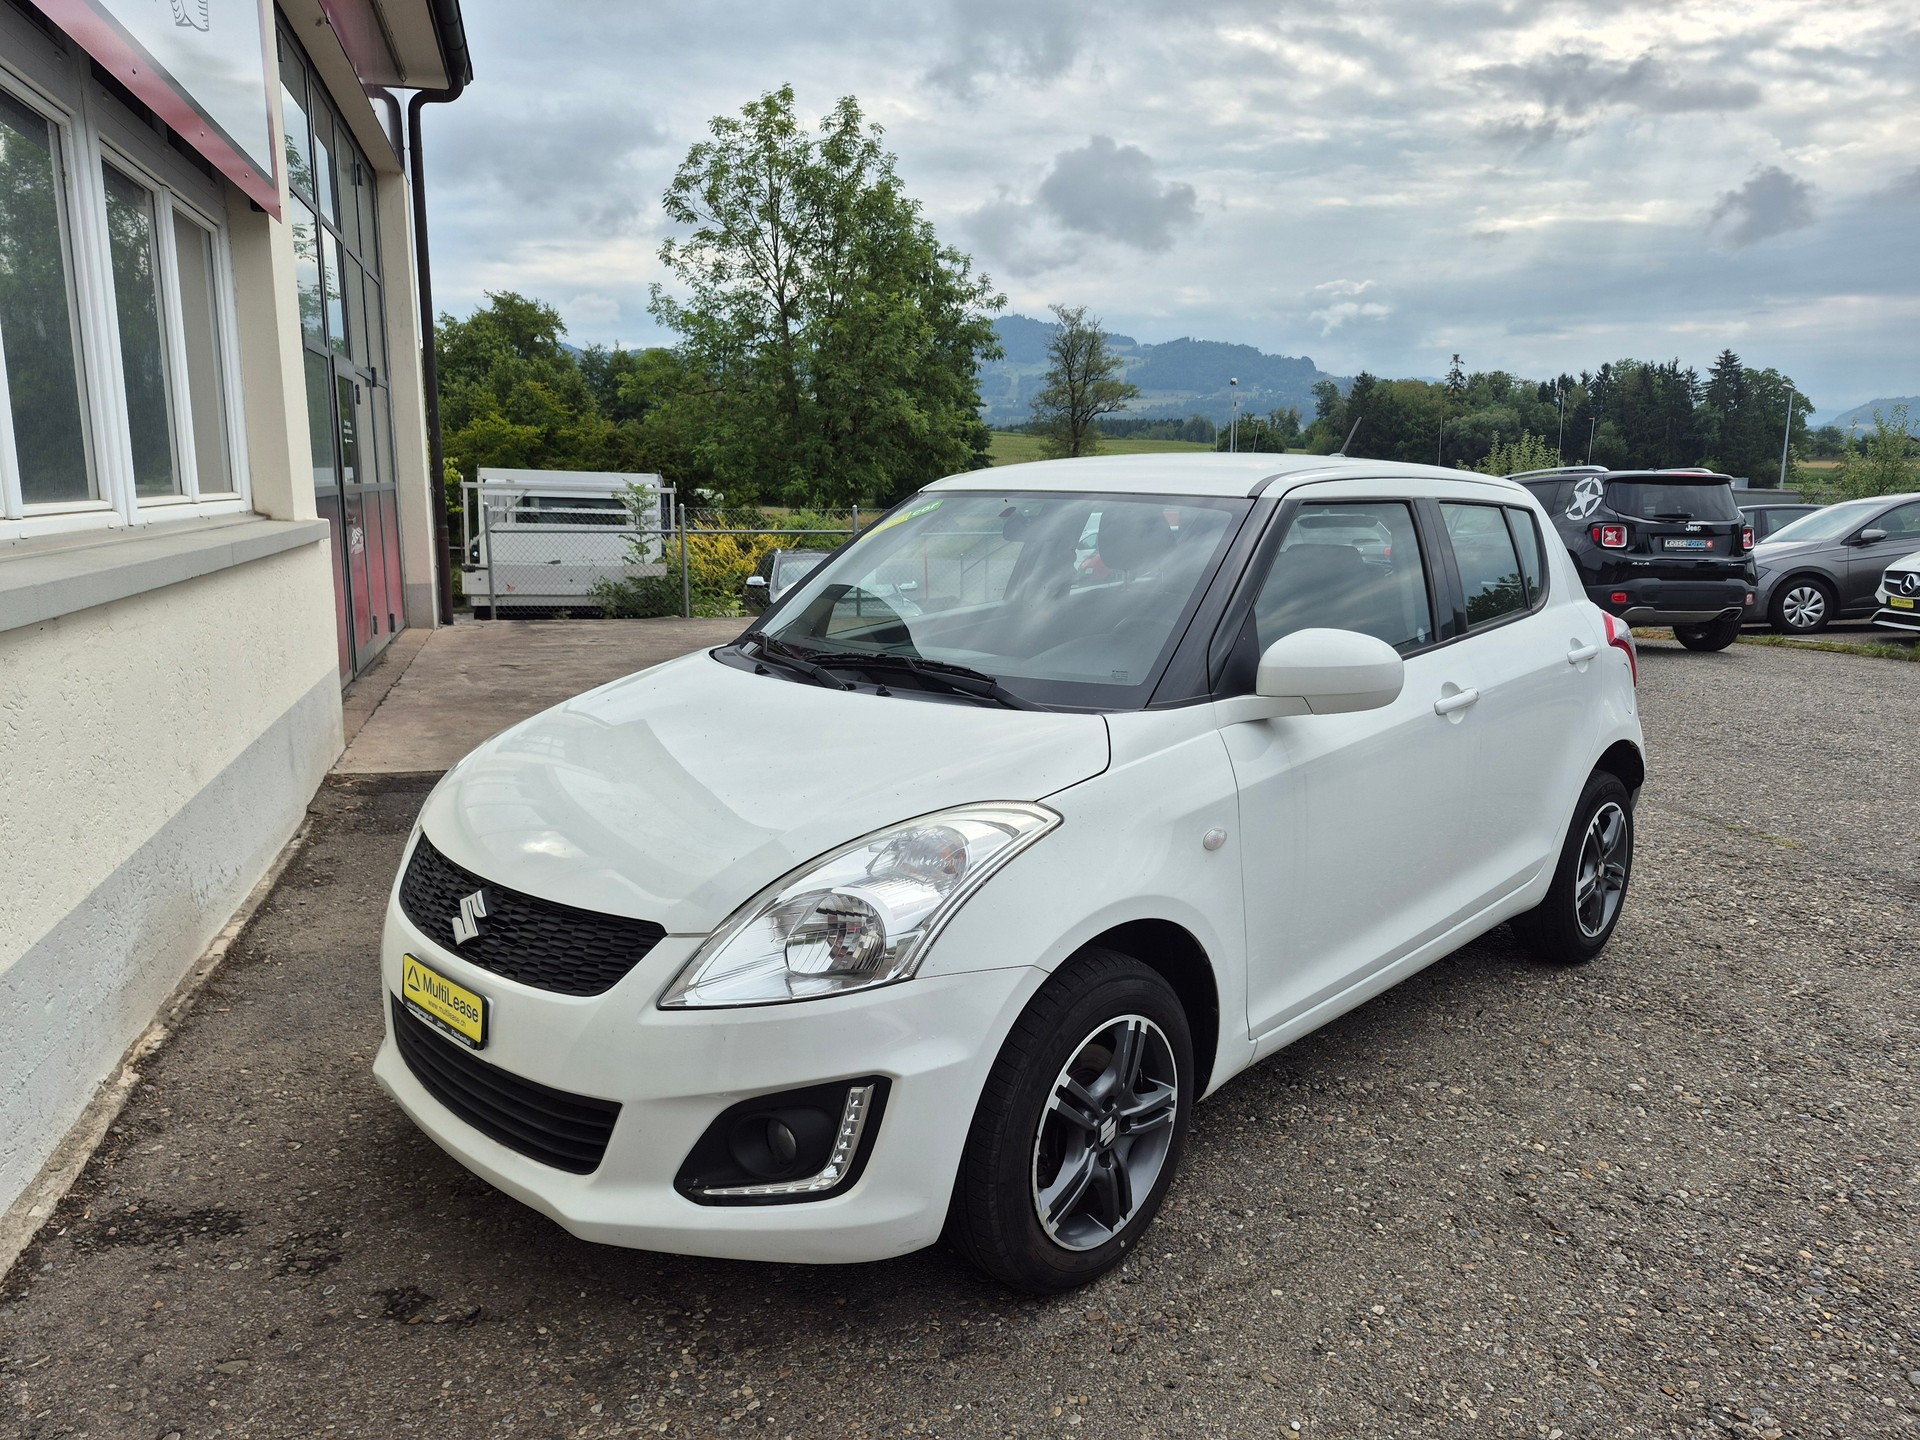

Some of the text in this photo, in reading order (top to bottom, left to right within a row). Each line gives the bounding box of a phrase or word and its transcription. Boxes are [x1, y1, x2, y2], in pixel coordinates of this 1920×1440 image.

[1685, 524, 1701, 532] Jeep
[1665, 539, 1706, 548] LeaseForce
[423, 973, 479, 1023] MultiLease
